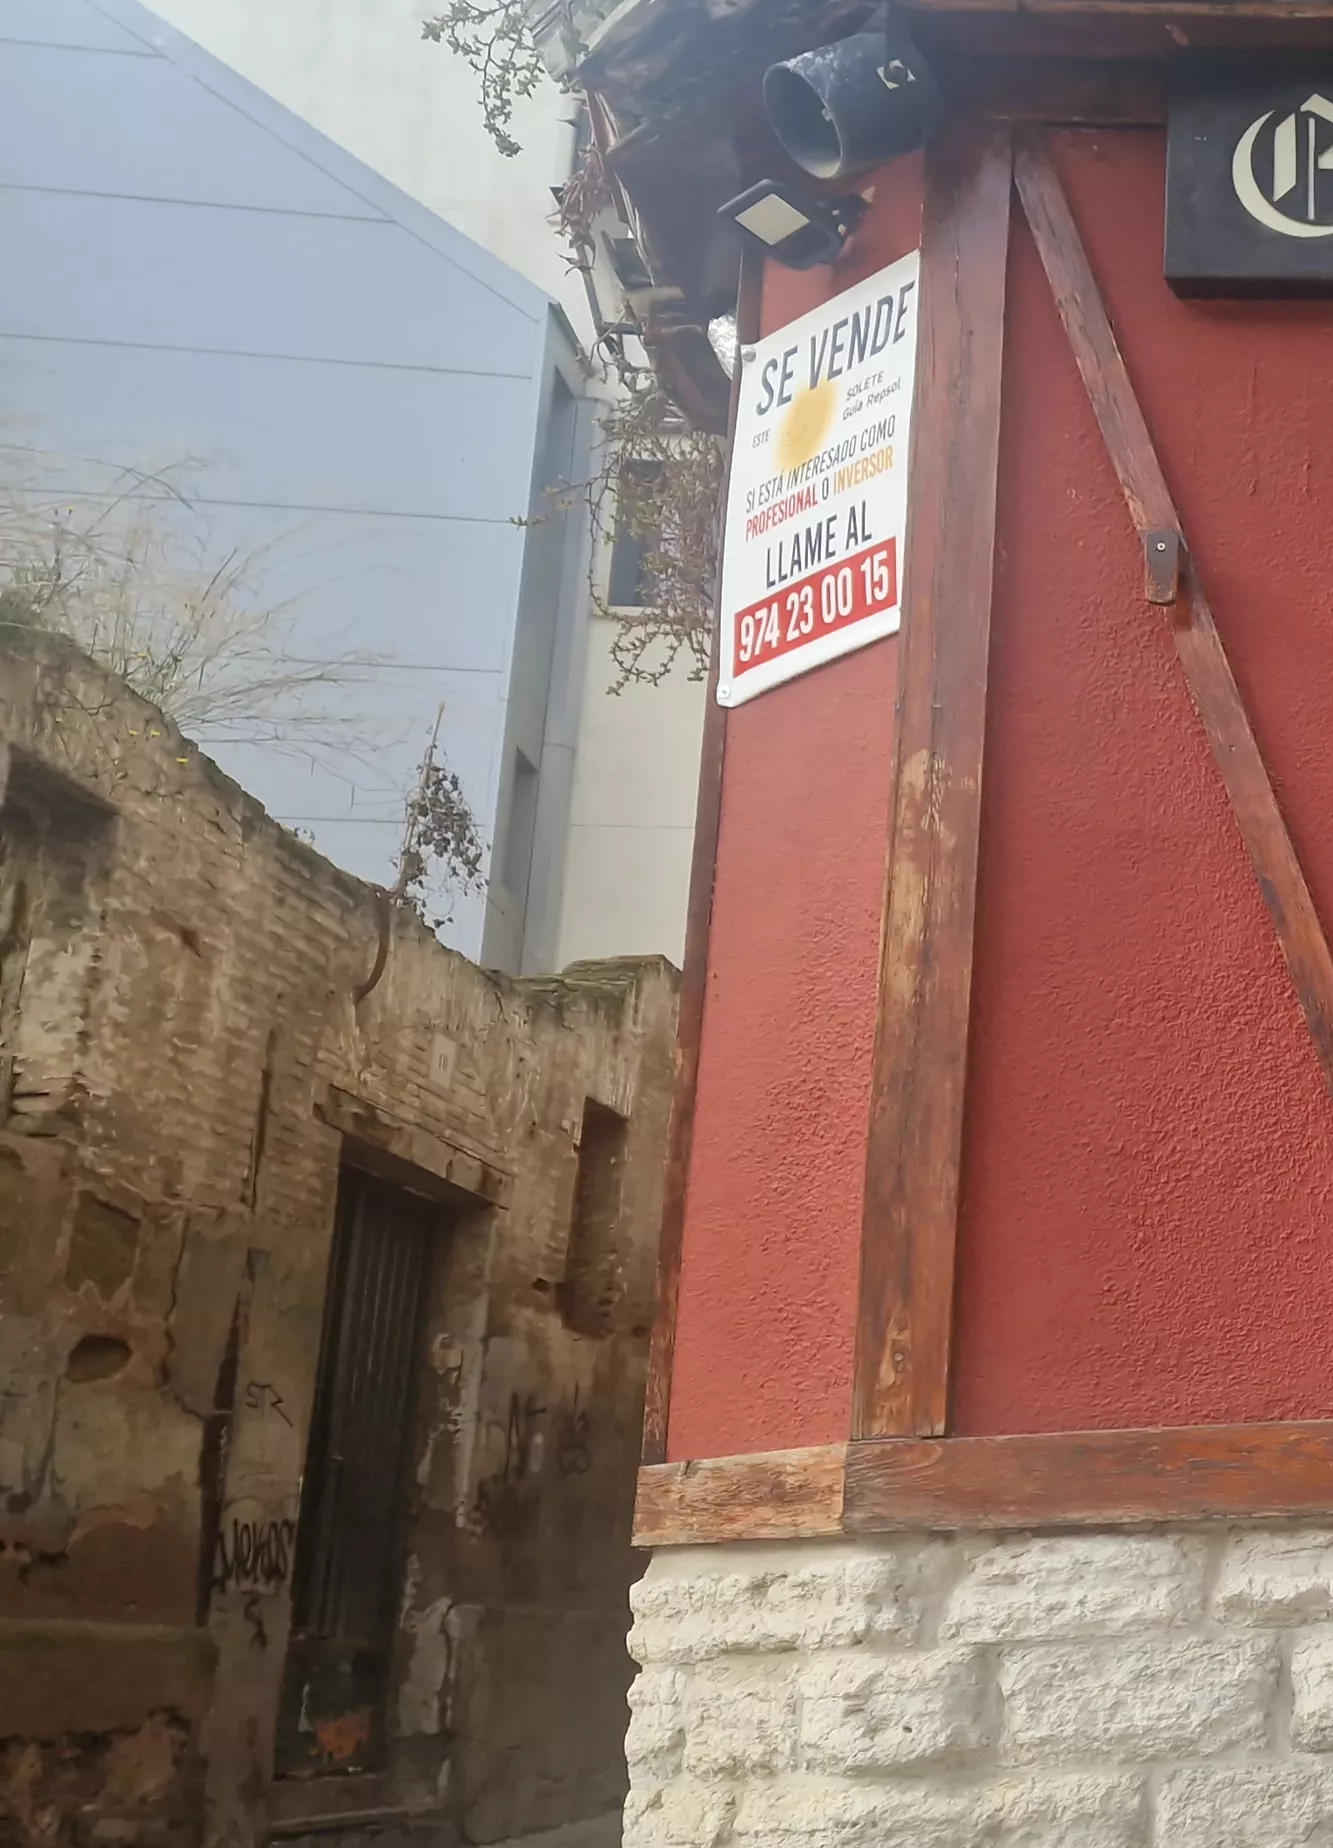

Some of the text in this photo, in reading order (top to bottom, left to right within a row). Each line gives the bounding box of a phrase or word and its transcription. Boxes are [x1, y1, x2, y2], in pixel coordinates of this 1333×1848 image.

[756, 280, 915, 416] SE VENDE
[846, 371, 884, 401] SOLETE
[752, 429, 771, 448] ESTE
[843, 377, 901, 421] Guía Repsol
[745, 445, 893, 541] PROFESIONAL O INVERSOR
[746, 415, 896, 513] SI ESTÁ INTERESADO COMO
[766, 500, 872, 589] LLAME AL
[739, 550, 889, 662] 974 23 00 15
